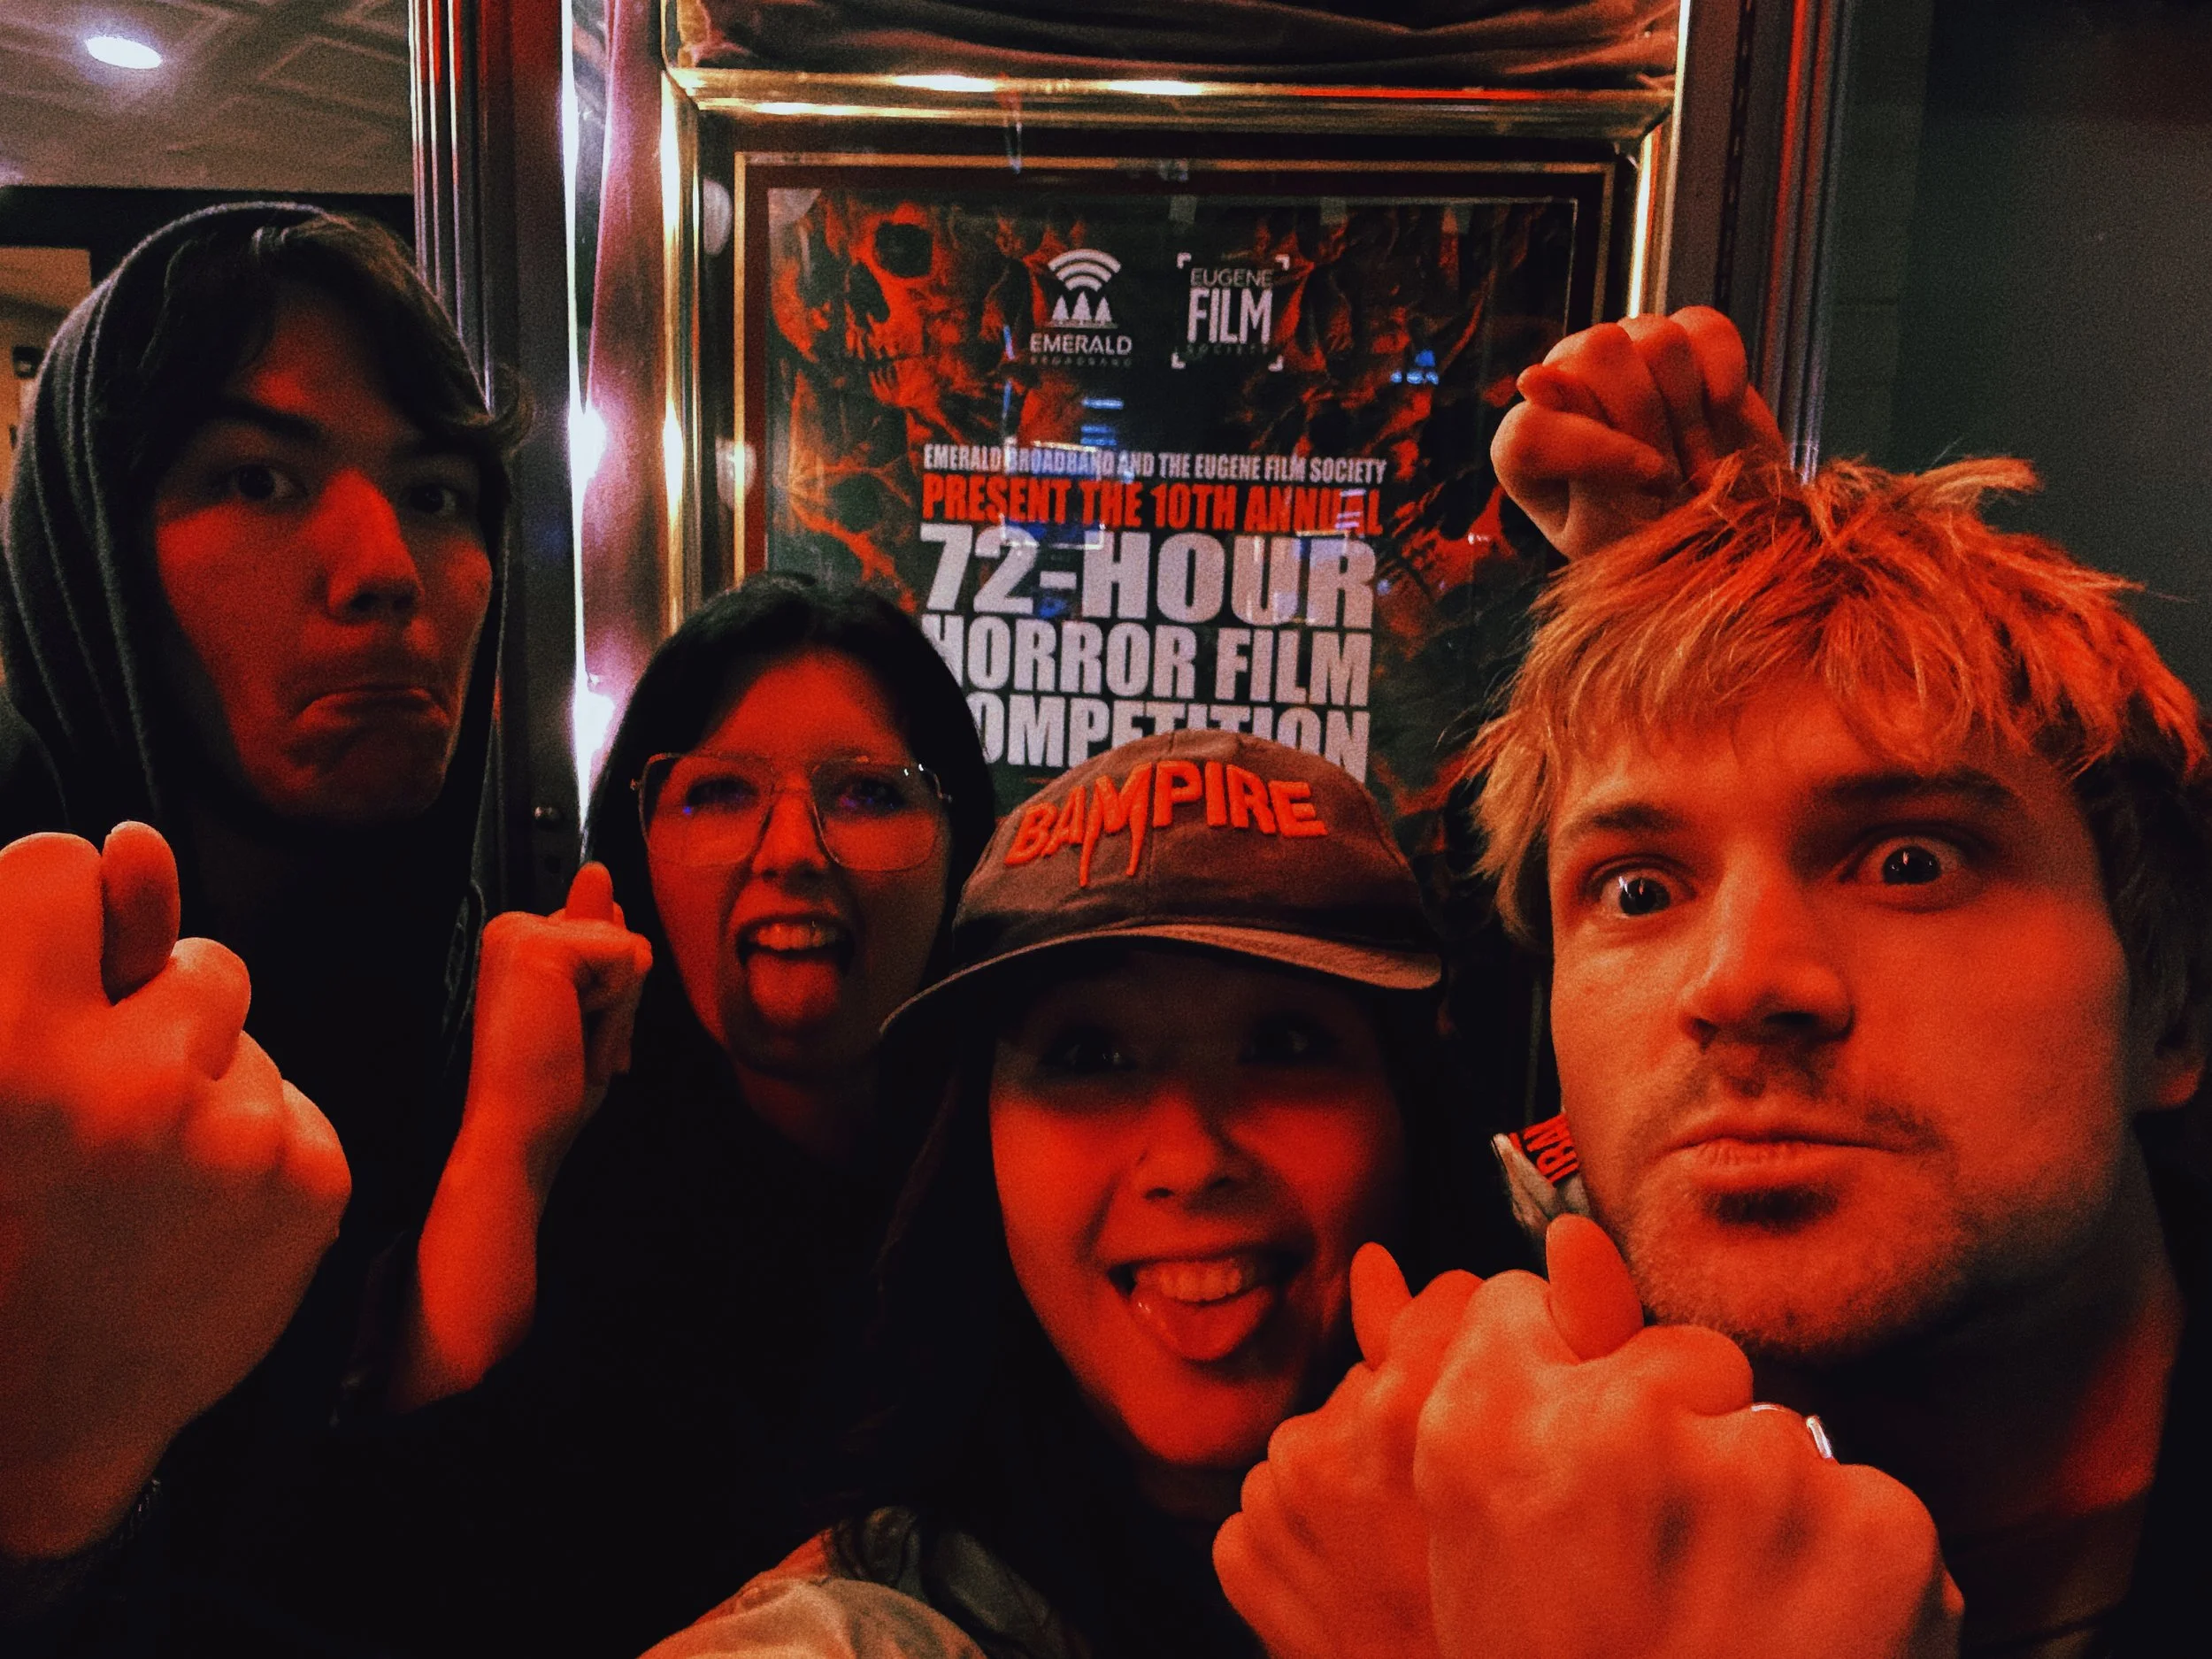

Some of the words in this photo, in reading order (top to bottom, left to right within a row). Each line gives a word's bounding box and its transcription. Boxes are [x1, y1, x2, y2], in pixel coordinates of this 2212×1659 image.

[1190, 267, 1273, 288] EUGENE
[1030, 333, 1133, 355] EMERALD
[1187, 287, 1272, 344] FILM
[924, 443, 1003, 472] EMERALD
[1117, 450, 1155, 478] AND
[1158, 452, 1191, 478] THE
[1194, 453, 1261, 480] EUGENE
[1263, 454, 1308, 481] FILM
[1310, 457, 1387, 484] SOCIETY
[922, 472, 1071, 525] PRESENT
[1079, 480, 1142, 527] THE
[1151, 483, 1238, 529] 10TH
[1242, 485, 1384, 536] ANNUAL
[919, 523, 1377, 629] 72-HOUR
[921, 613, 1197, 699] HORROR
[1215, 626, 1372, 707] FILM
[965, 691, 1371, 783] OMPETTON
[1003, 759, 1328, 887] BAMPIRE
